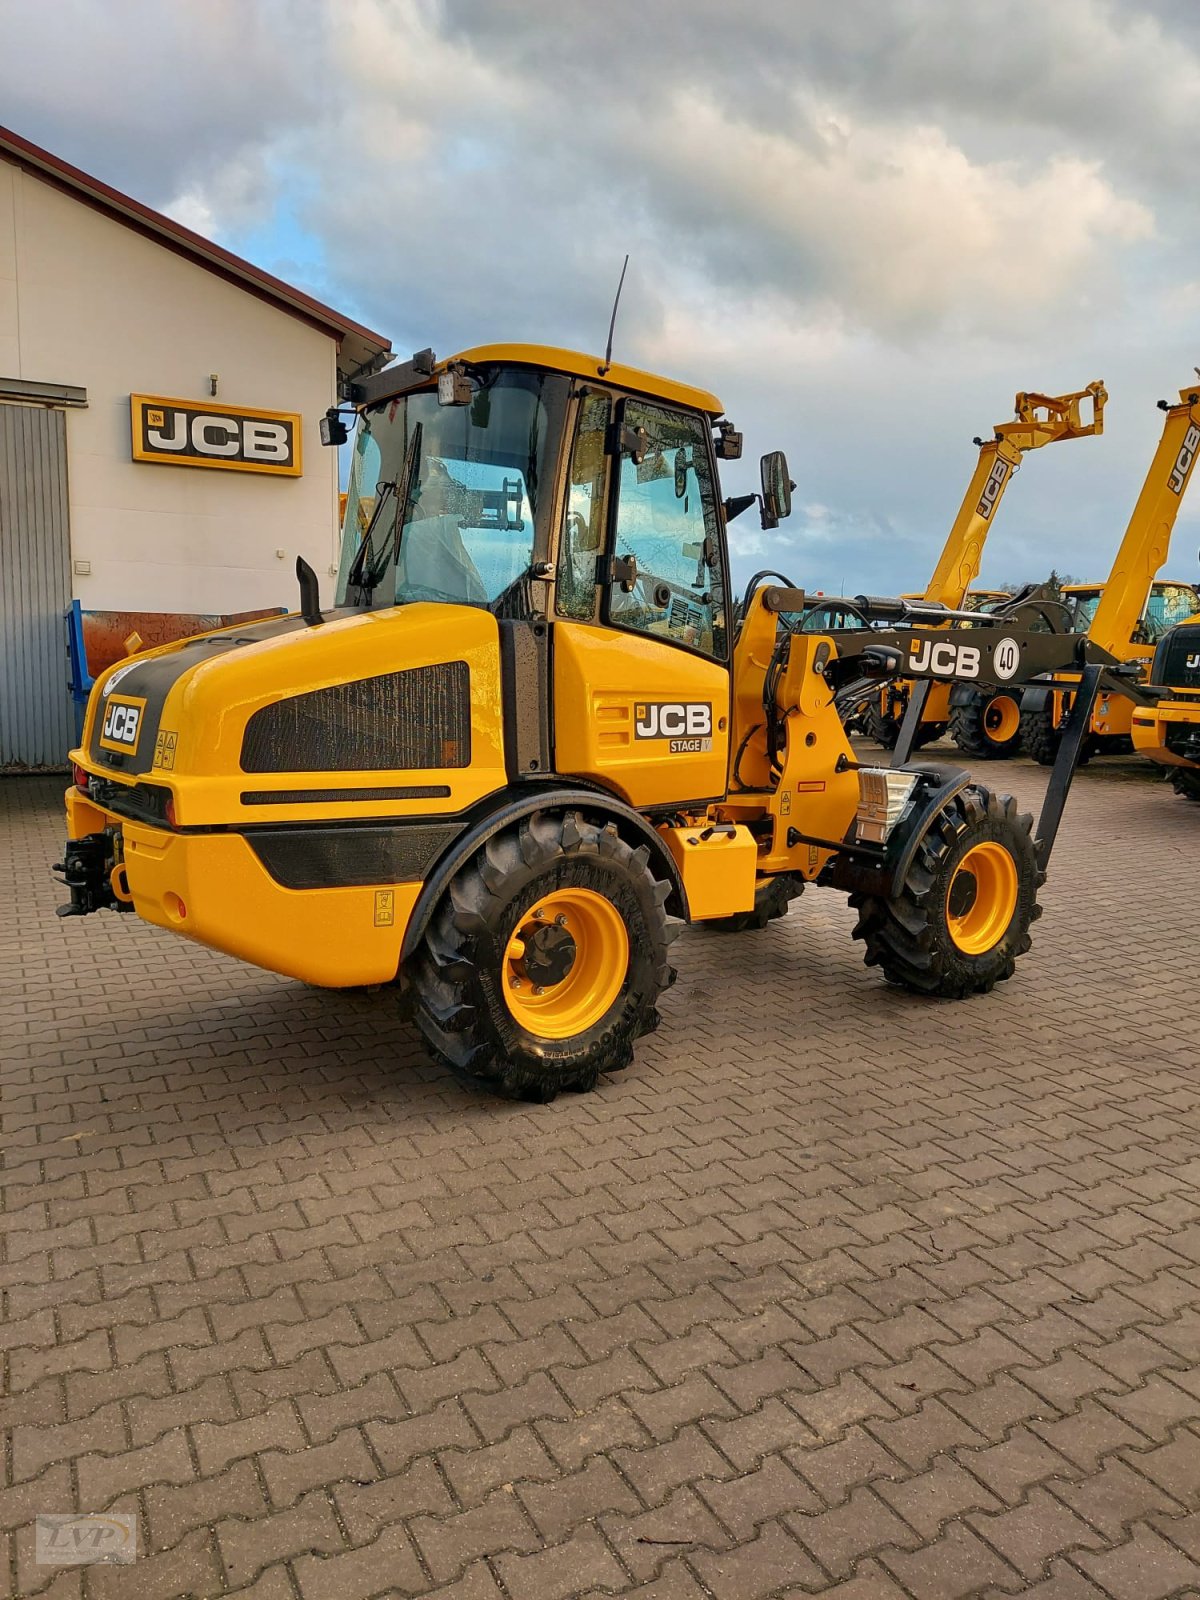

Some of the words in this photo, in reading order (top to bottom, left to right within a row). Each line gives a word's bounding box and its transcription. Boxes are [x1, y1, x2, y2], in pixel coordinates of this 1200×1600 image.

[148, 412, 289, 461] JCB
[1172, 425, 1200, 493] JCB
[980, 460, 1007, 518] JCB
[909, 640, 981, 678] JCB
[999, 646, 1014, 670] 40
[104, 705, 140, 742] JCB
[637, 704, 711, 737] JCB
[670, 740, 700, 752] STAGE
